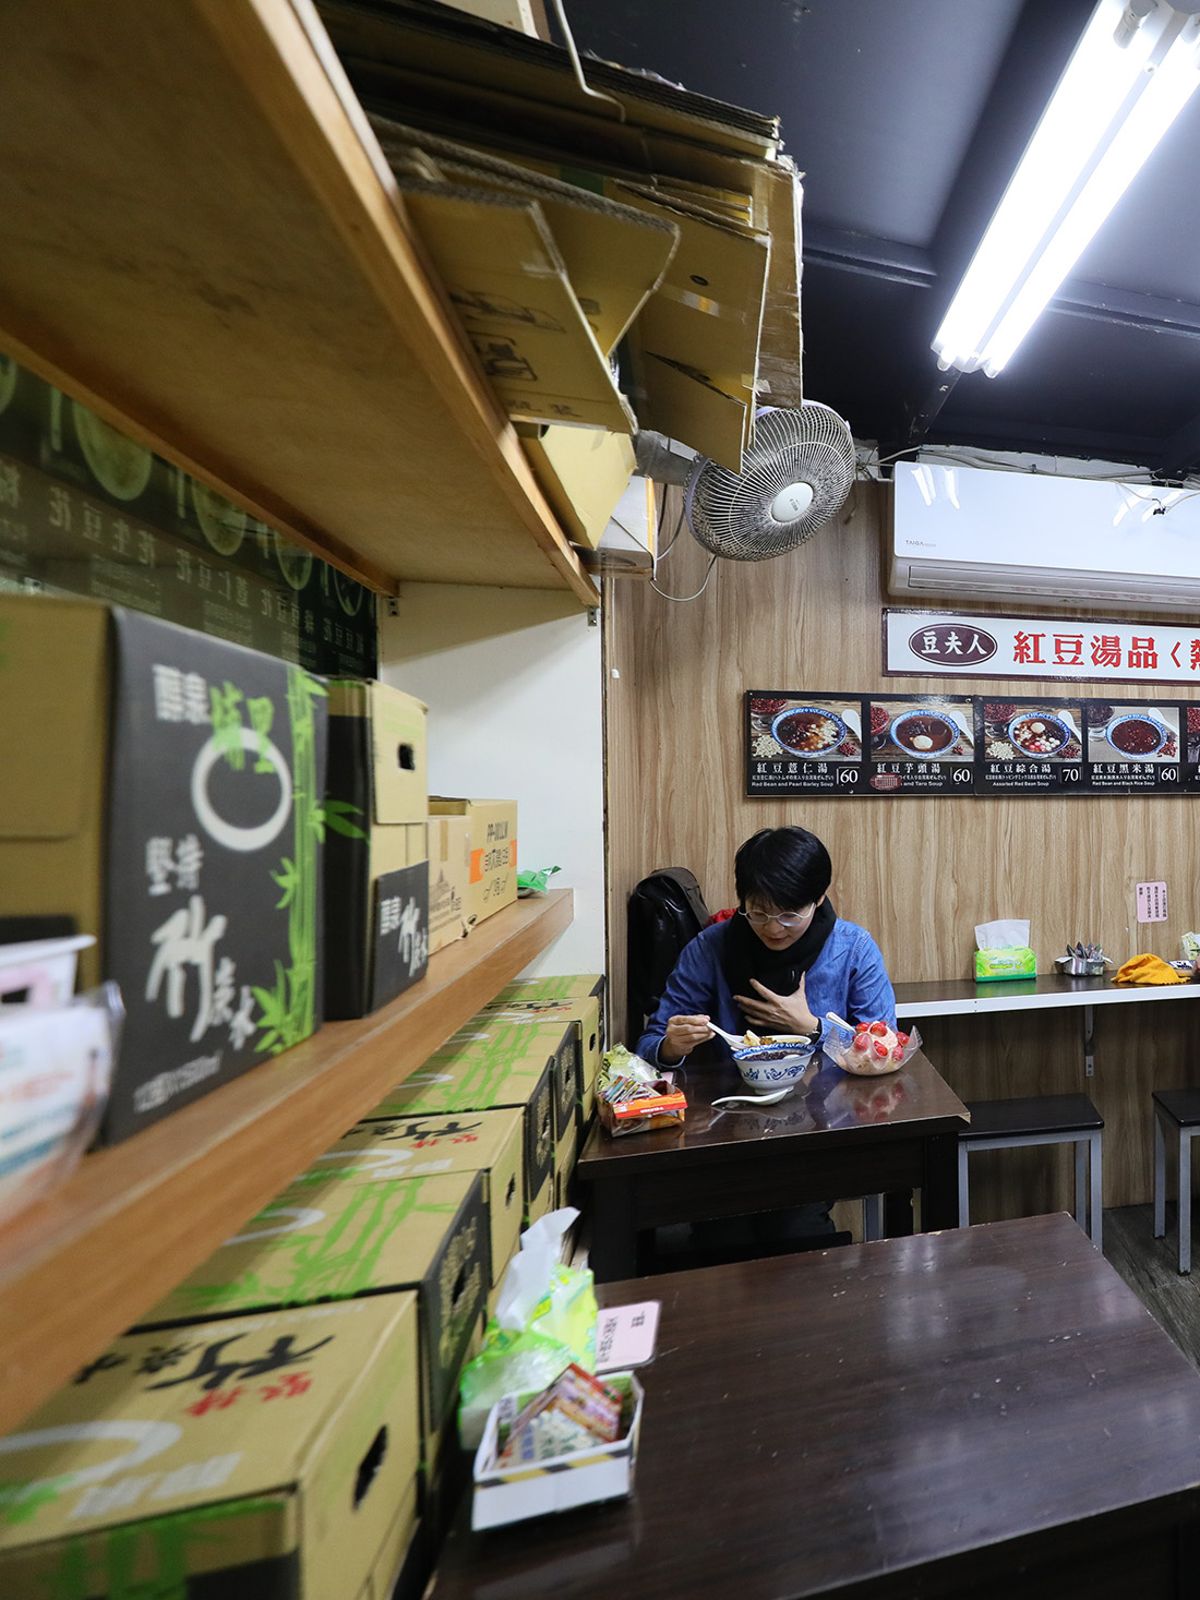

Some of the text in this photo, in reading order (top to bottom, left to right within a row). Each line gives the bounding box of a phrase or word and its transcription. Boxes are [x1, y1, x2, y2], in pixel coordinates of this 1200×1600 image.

[920, 633, 987, 657] 豆夫人
[840, 769, 858, 784] 60
[953, 768, 970, 783] 60
[1062, 768, 1079, 782] 70
[1161, 768, 1176, 781] 60
